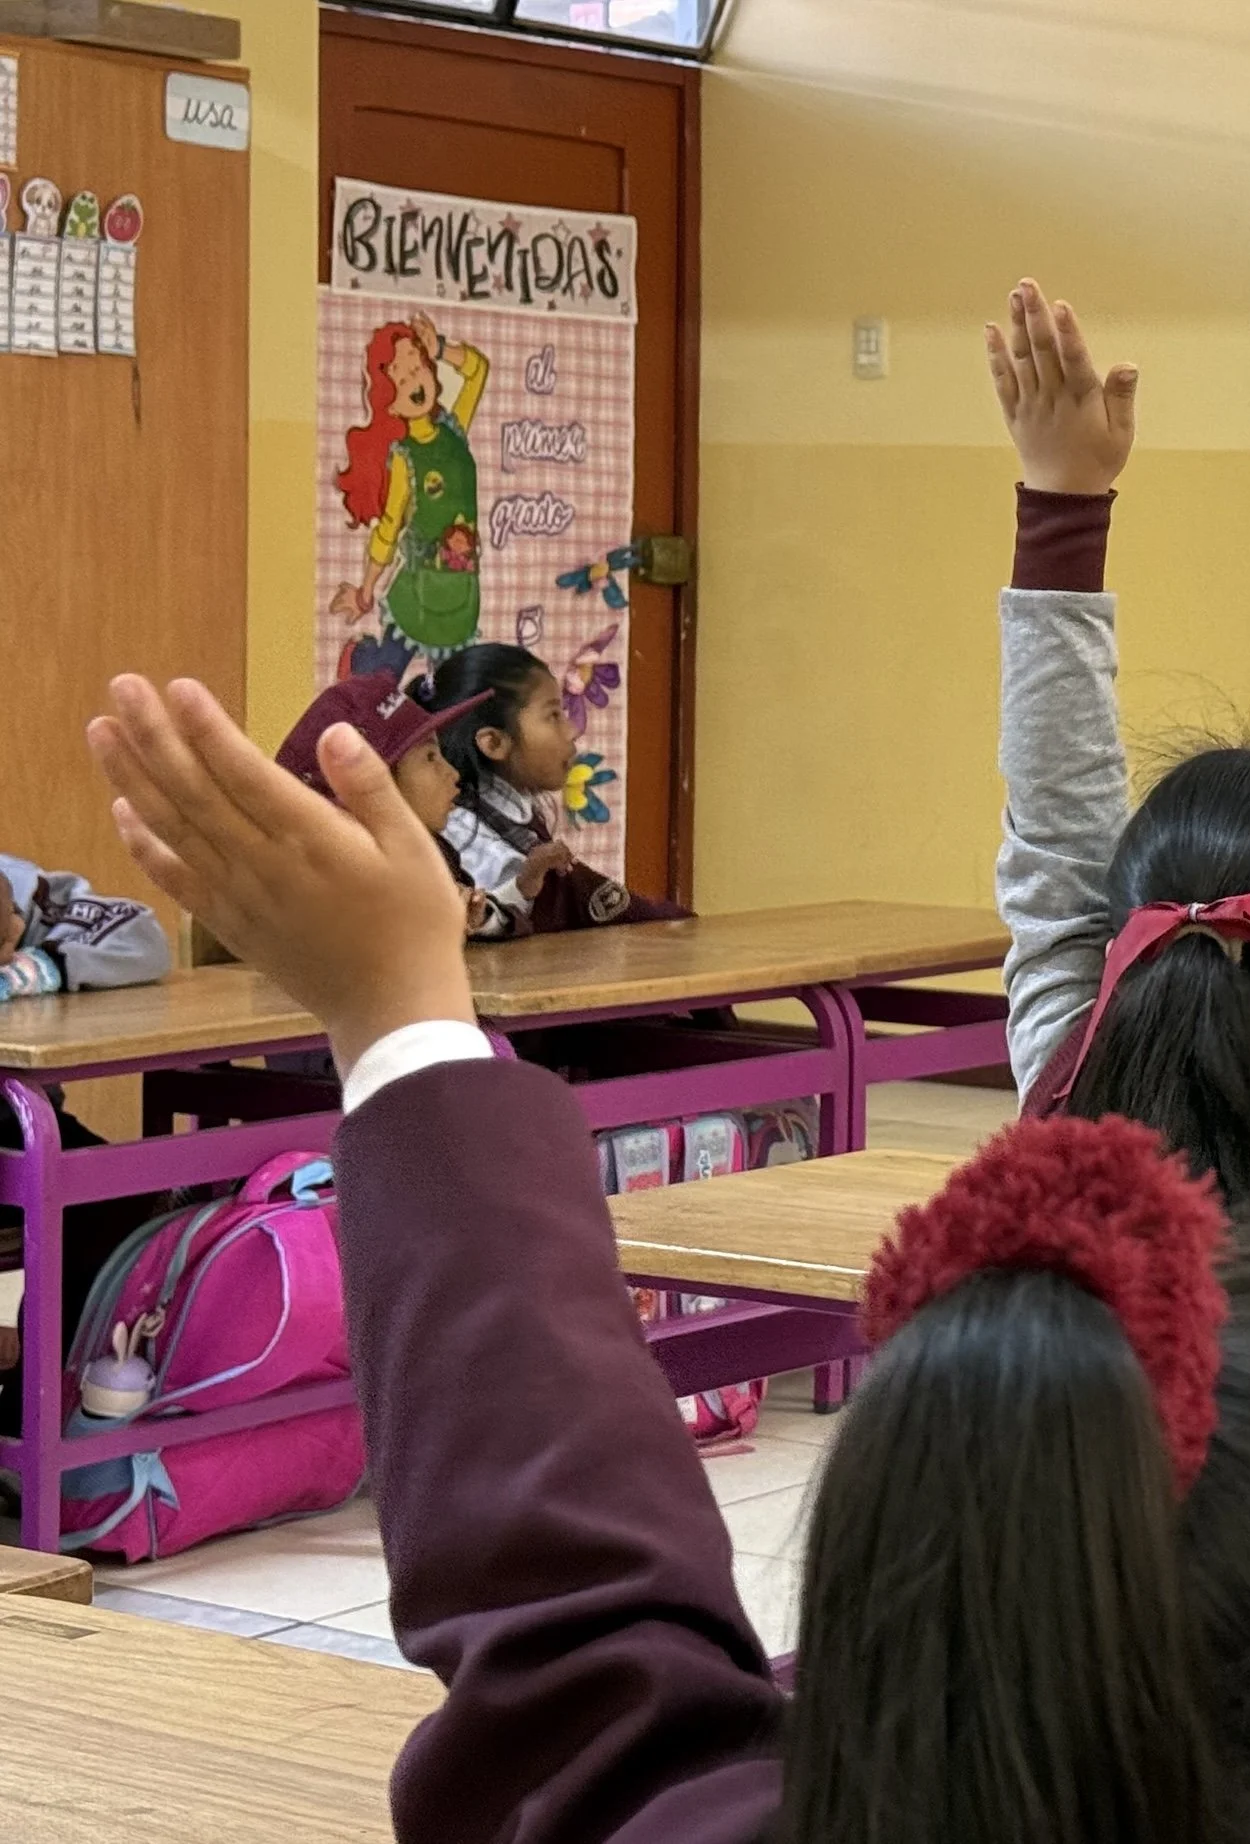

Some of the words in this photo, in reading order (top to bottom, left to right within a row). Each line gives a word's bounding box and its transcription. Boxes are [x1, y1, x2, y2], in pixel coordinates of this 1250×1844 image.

[183, 98, 237, 130] usa
[343, 198, 619, 304] BIENVENIDAS
[525, 344, 556, 394] al
[501, 418, 586, 473] primer
[489, 491, 575, 550] grado
